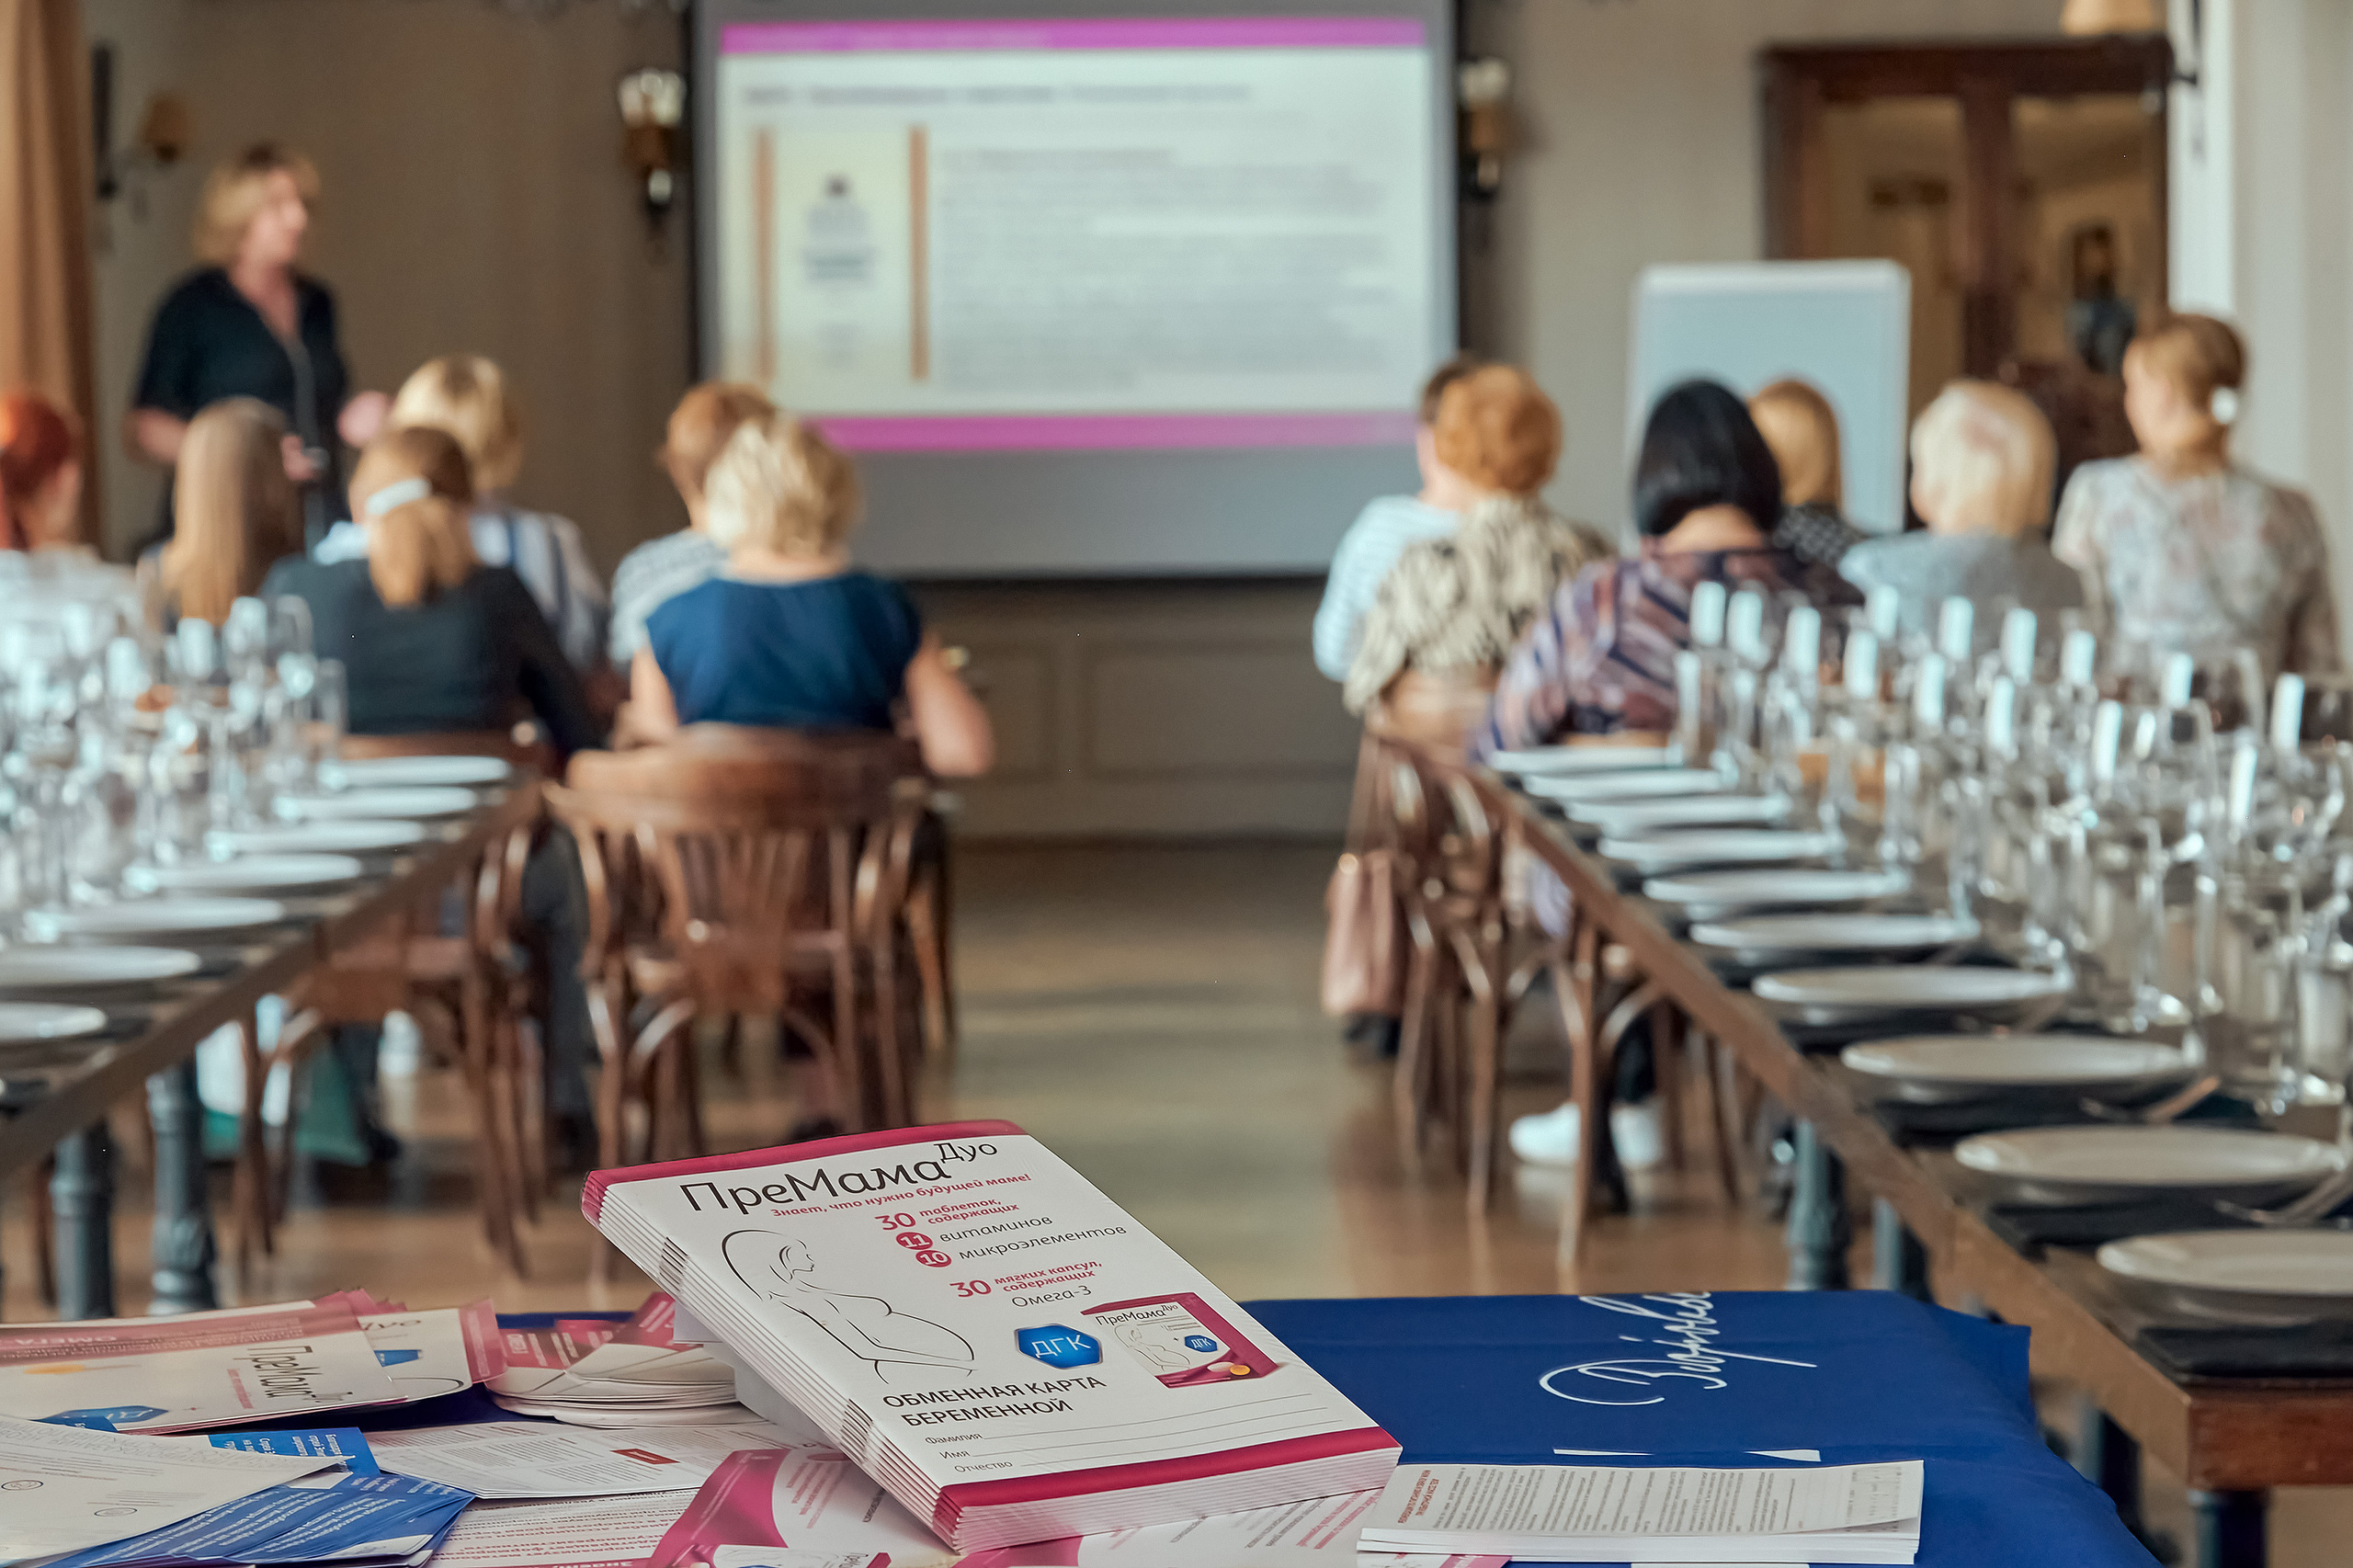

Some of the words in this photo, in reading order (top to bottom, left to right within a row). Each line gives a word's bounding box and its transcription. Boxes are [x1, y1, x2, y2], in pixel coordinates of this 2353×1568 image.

[679, 1161, 952, 1215] ПреМама
[934, 1142, 998, 1163] Дуо
[770, 1203, 828, 1218] Знает,
[828, 1199, 862, 1212] что
[865, 1191, 915, 1206] нужно
[916, 1178, 984, 1199] будущей
[986, 1173, 1032, 1187] маме!
[919, 1198, 1002, 1218] таблеток,
[927, 1203, 1020, 1225] содержащих
[874, 1212, 916, 1231] 30
[898, 1233, 930, 1249] 11
[939, 1216, 1053, 1243] витаминов
[919, 1251, 949, 1266] 10
[959, 1225, 1128, 1261] микроэлементов
[994, 1268, 1046, 1286] мягких
[1048, 1259, 1103, 1276] капсул,
[1003, 1268, 1096, 1292] содержащих
[949, 1279, 993, 1298] 30
[1011, 1285, 1093, 1308] Омега-3
[1095, 1309, 1166, 1326] ПреМама
[1030, 1334, 1093, 1358] ДГК
[1190, 1337, 1212, 1349] ДГК
[882, 1383, 1027, 1408] ОБМЕННАЯ
[1025, 1376, 1108, 1395] КАРТА
[901, 1398, 1074, 1427] БЕРЕМЕННОЙ
[925, 1433, 983, 1445] Фамилия
[939, 1449, 971, 1460] Имя
[954, 1460, 1014, 1473] Отчество
